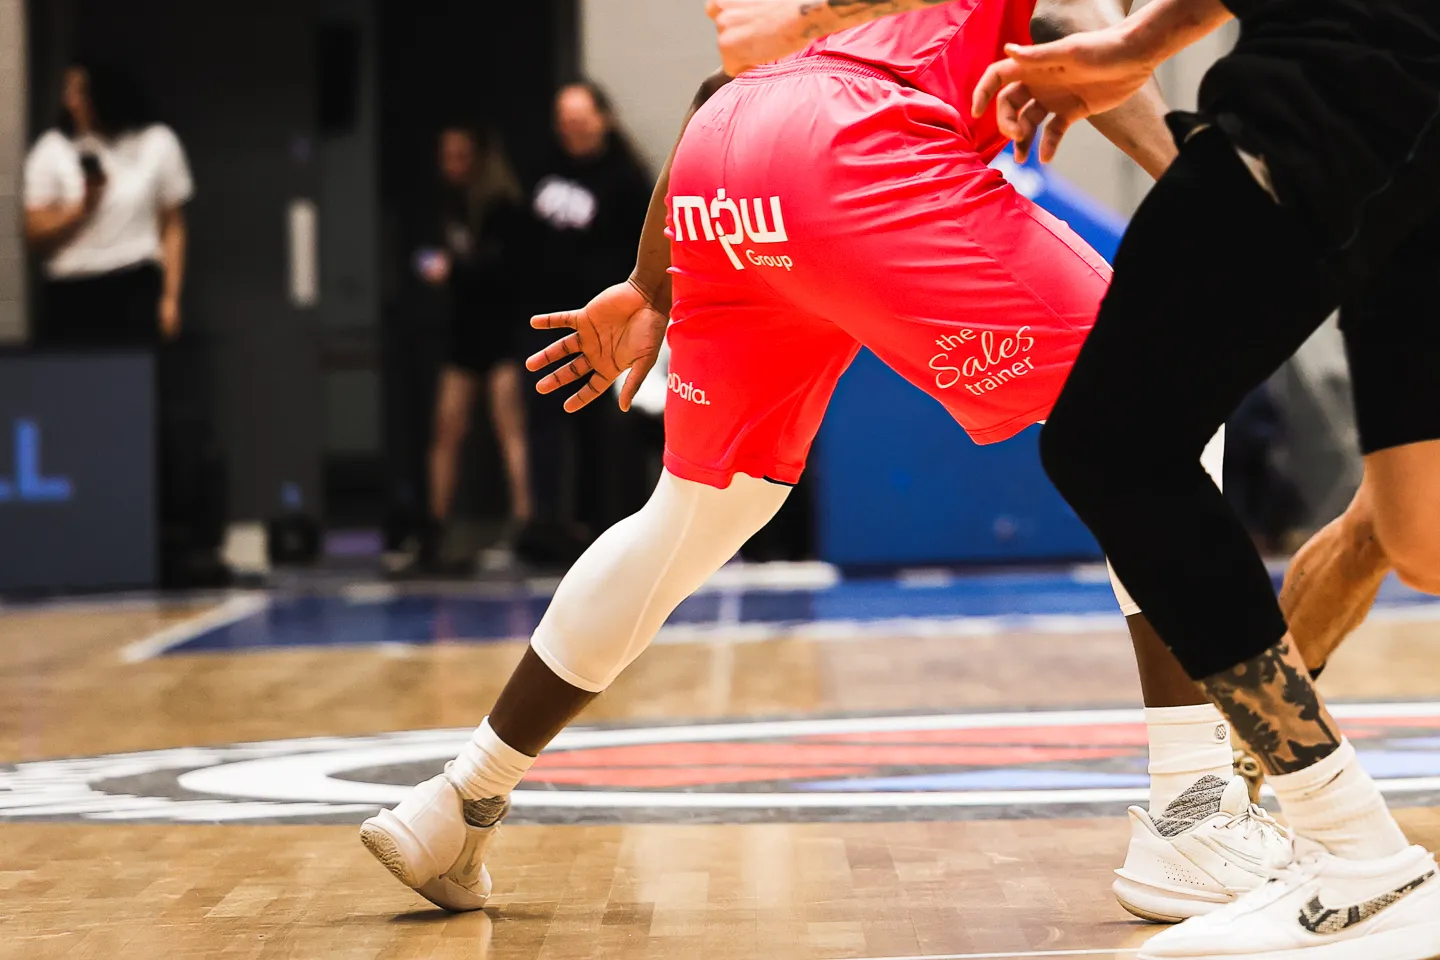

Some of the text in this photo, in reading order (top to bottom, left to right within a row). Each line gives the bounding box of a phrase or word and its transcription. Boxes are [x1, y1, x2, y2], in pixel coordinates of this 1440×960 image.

[672, 187, 789, 270] mpw
[745, 249, 793, 271] Group
[928, 325, 1035, 389] Sales
[935, 328, 977, 351] the
[964, 356, 1035, 396] trainer
